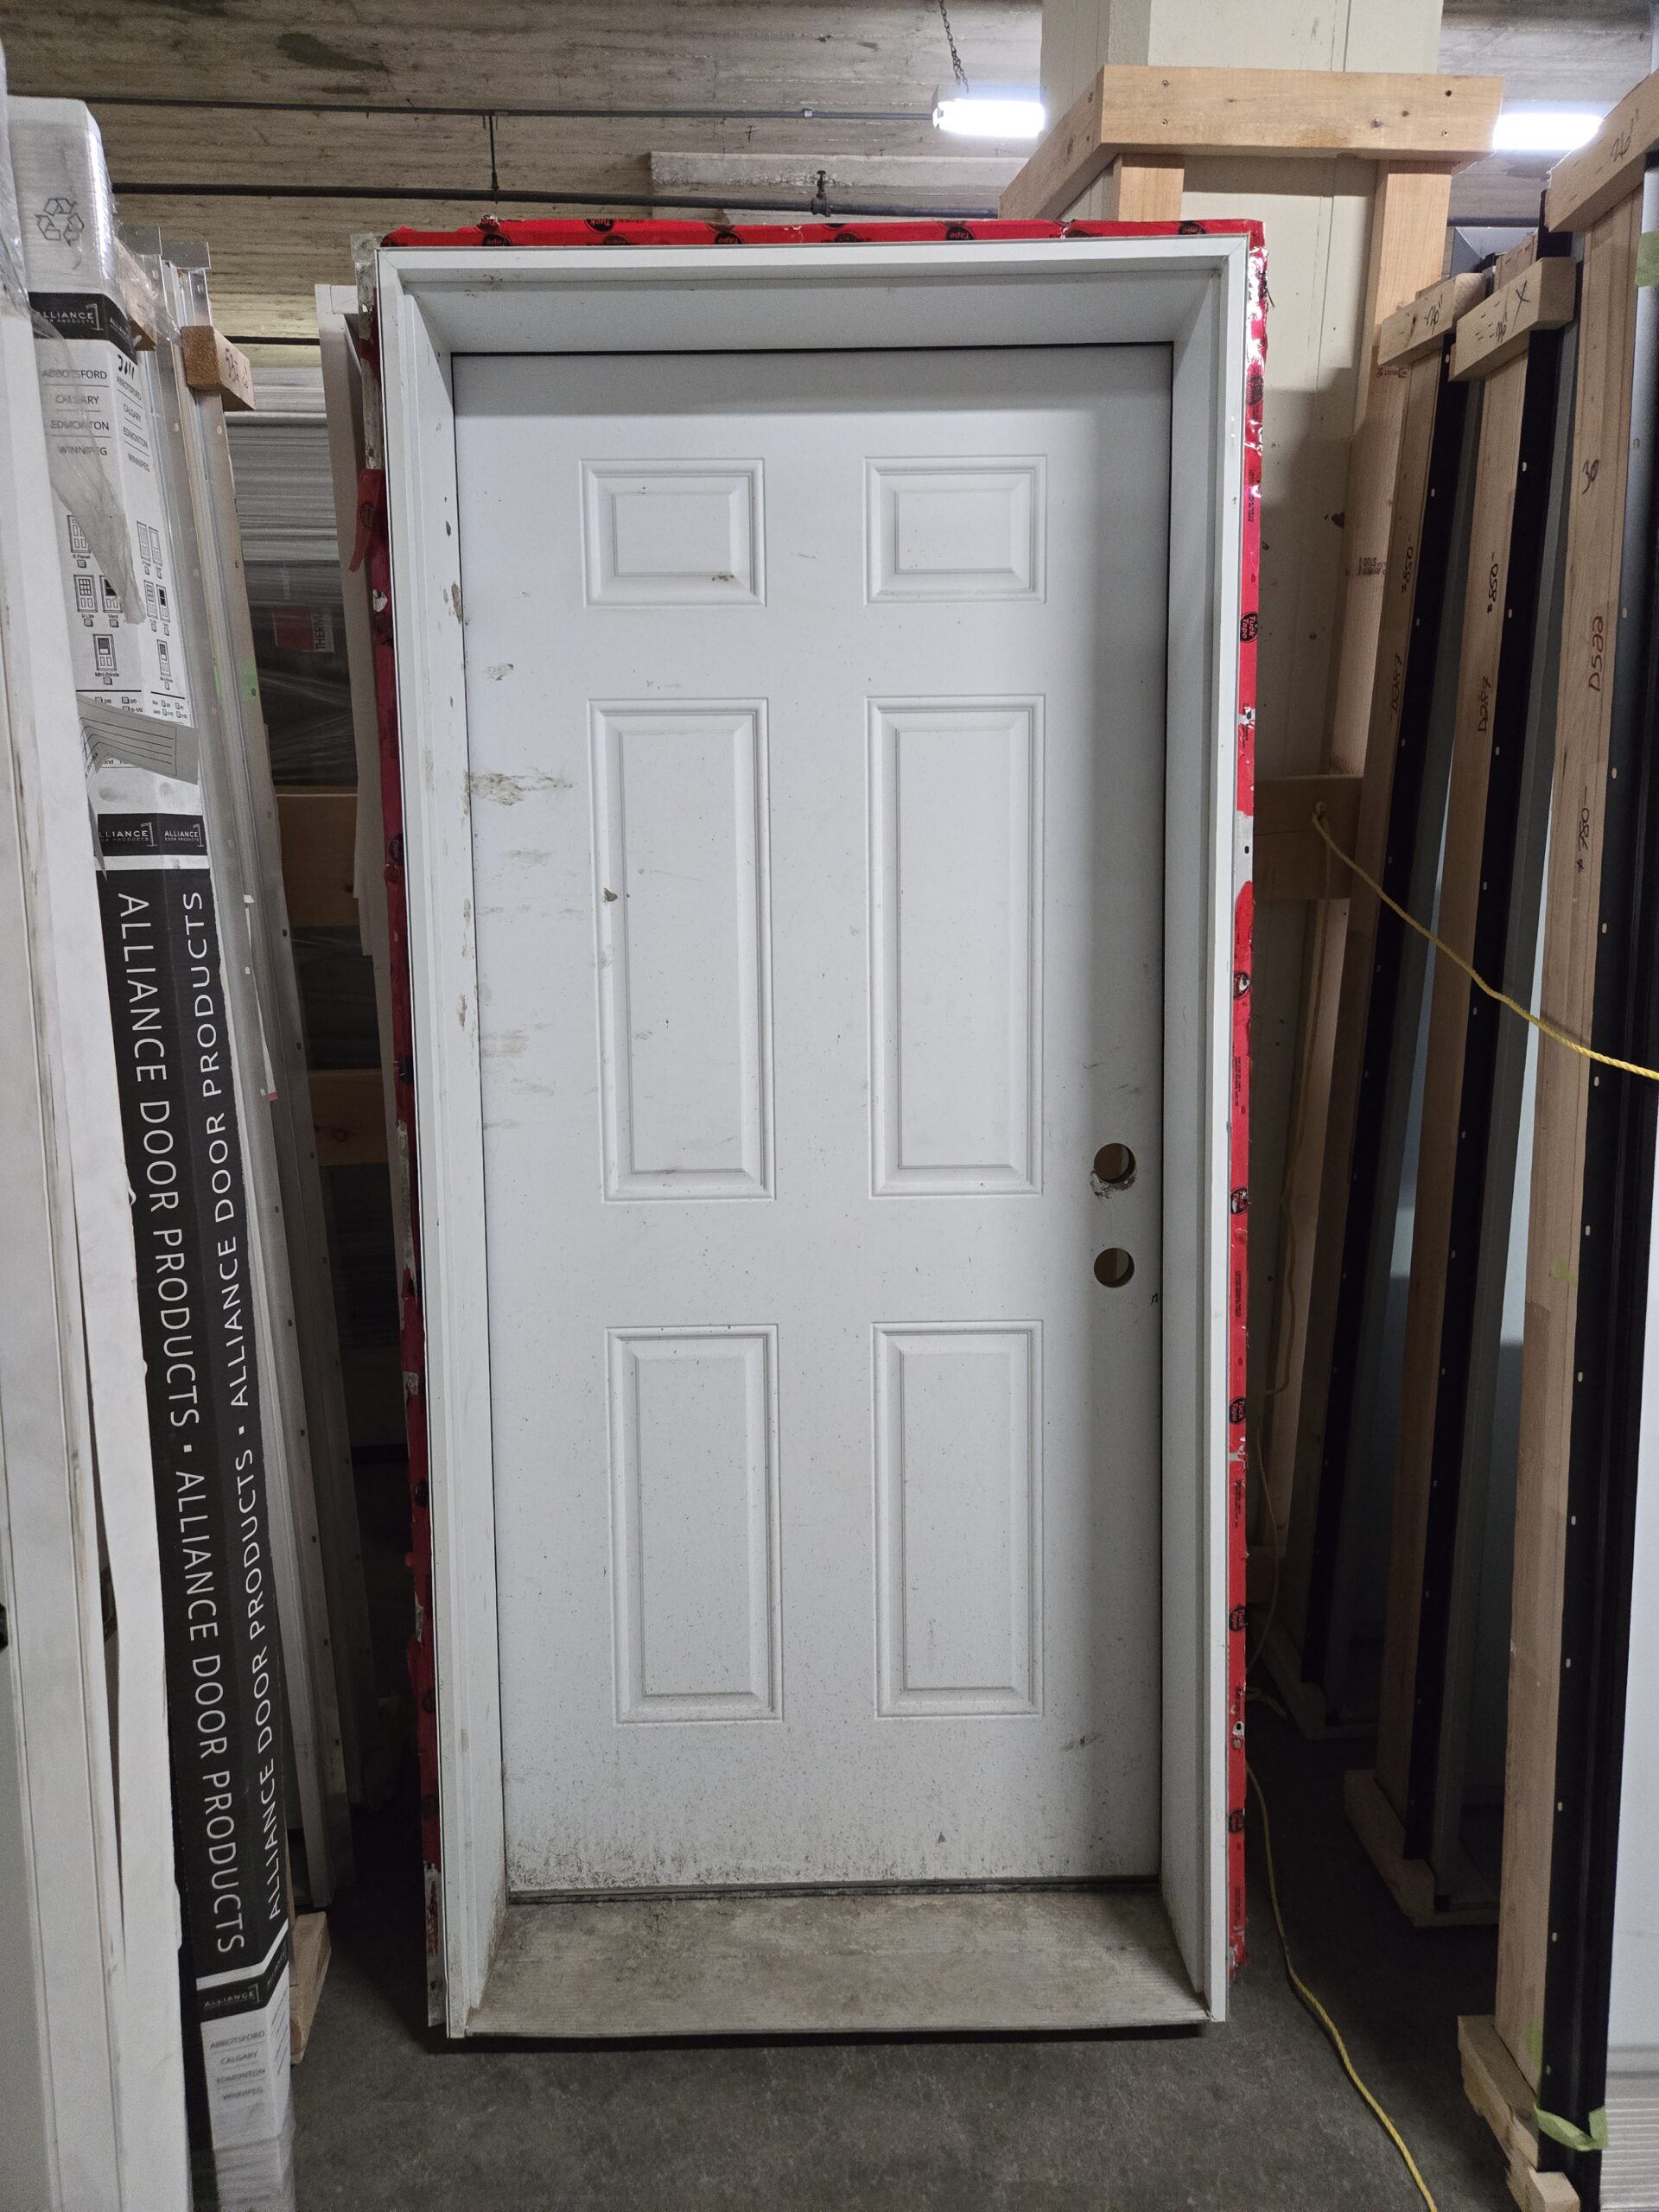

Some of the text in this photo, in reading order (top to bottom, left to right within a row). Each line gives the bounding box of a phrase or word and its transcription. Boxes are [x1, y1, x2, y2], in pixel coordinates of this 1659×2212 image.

[43, 311, 95, 320] LLIANCE
[55, 394, 99, 404] CALARY
[1248, 615, 1256, 637] Tuck
[164, 830, 199, 838] ALLIANCE
[182, 892, 222, 1097] PRODUCTS
[207, 1113, 235, 1223] DOOR
[215, 1236, 249, 1407] ALLIANCE
[118, 893, 245, 1952] ALLIANCE DOOR PRODUCTS ALLIANCE DOOR PRODUCTS
[231, 1450, 265, 1641] PRODUCTS
[251, 1646, 273, 1754] DOOR
[259, 1759, 281, 1921] ALLIANCE
[209, 2030, 265, 2050] ABBOTSFORD
[220, 2050, 258, 2065] CALGARY
